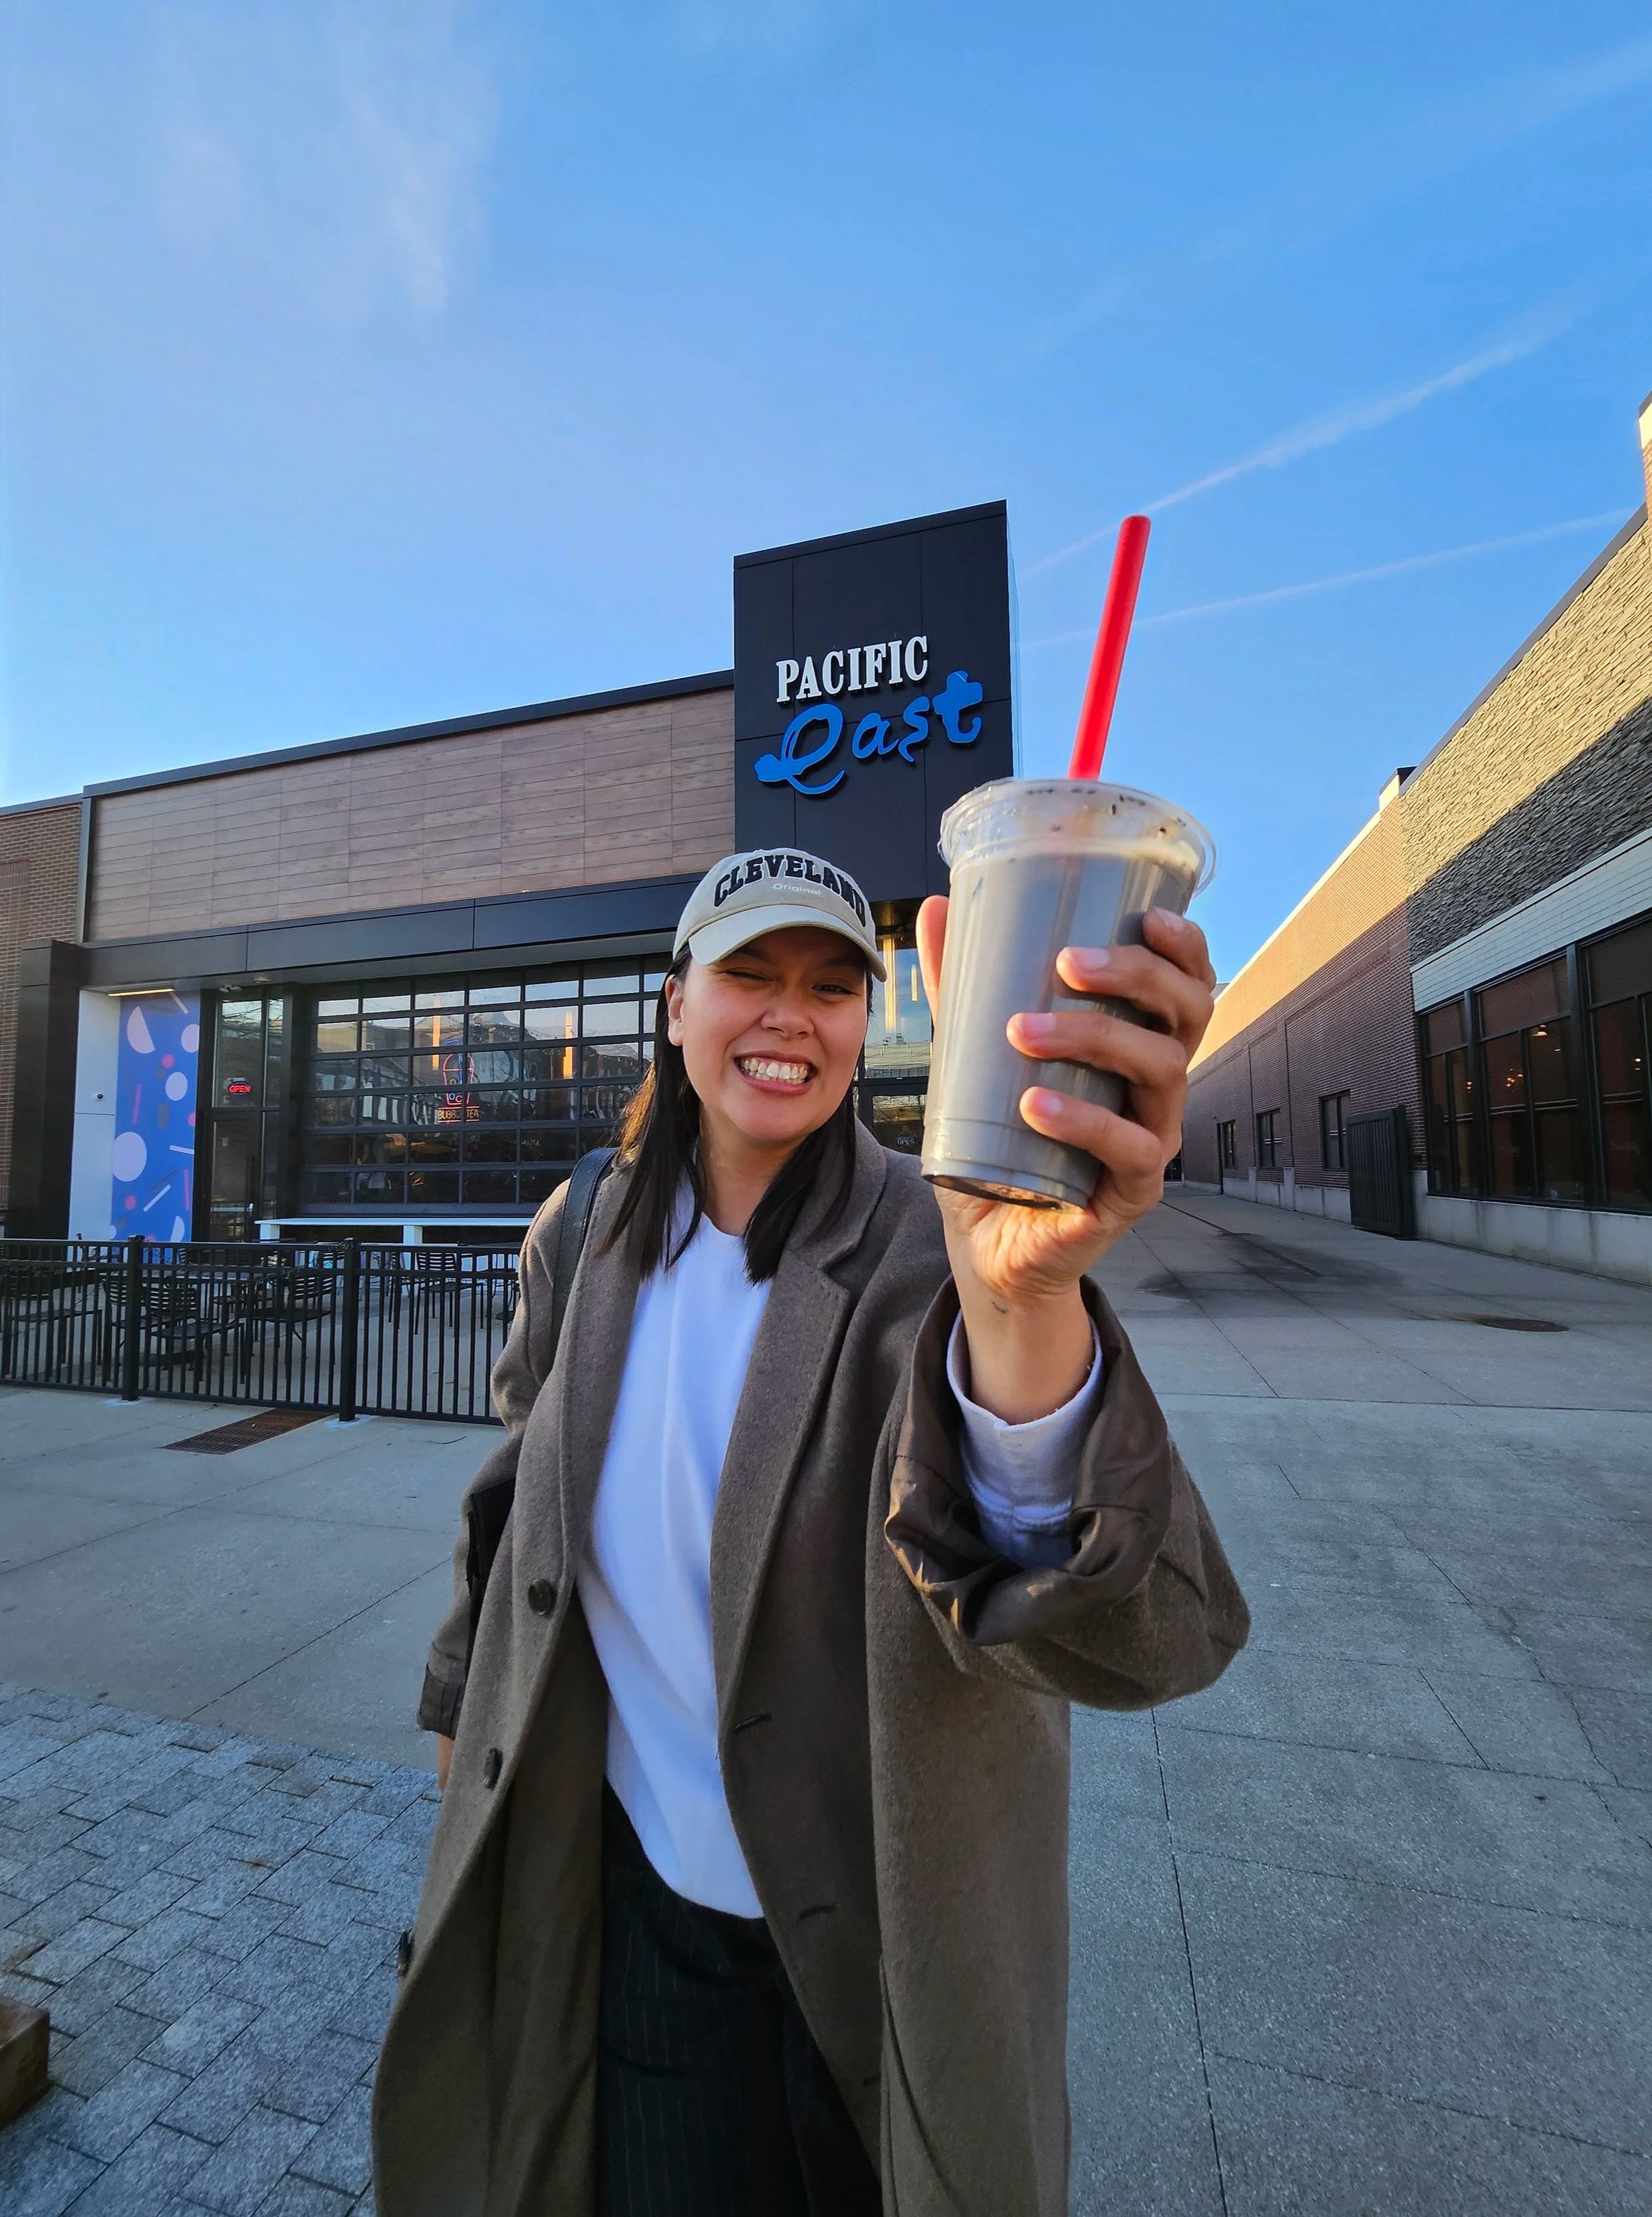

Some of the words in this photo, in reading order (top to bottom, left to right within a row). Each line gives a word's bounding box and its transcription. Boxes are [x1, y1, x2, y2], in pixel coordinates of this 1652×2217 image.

[776, 635, 928, 702] PACIFIC
[714, 854, 866, 927] CLEVELAND
[773, 883, 821, 895] Original
